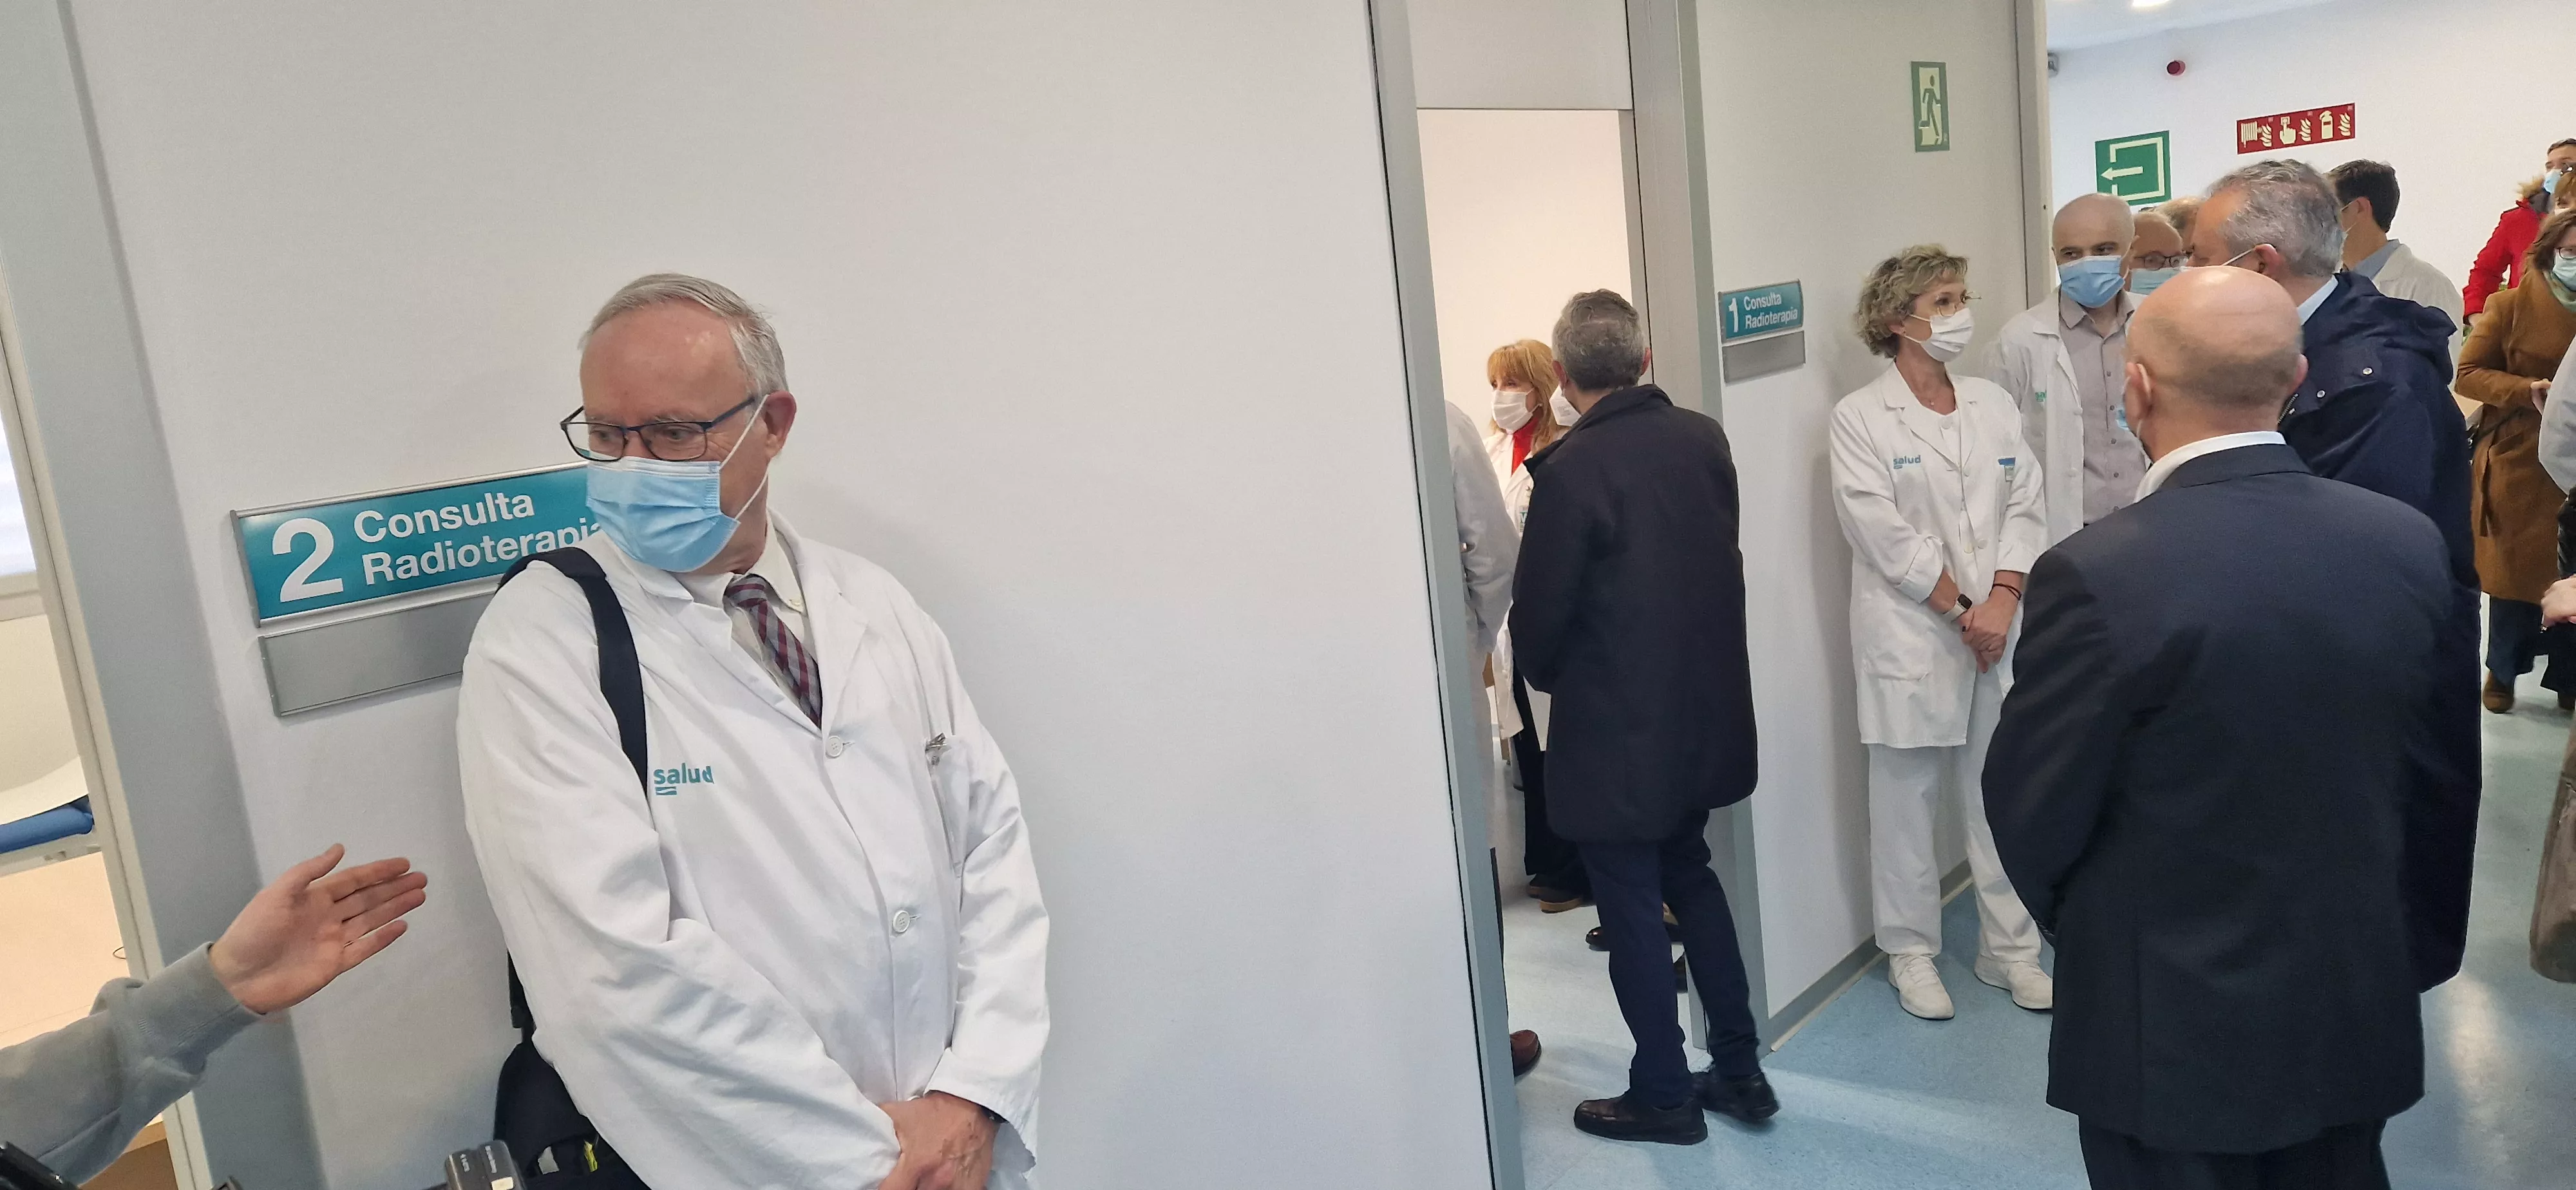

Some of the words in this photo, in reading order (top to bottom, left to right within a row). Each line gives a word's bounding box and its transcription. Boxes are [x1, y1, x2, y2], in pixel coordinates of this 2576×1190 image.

[1743, 292, 1782, 311] Consulta
[1728, 298, 1739, 333] 1
[1745, 306, 1798, 330] Radioterapia
[1893, 454, 1921, 464] salud
[354, 492, 535, 543] Consulta
[272, 518, 343, 603] 2
[653, 762, 714, 784] salud
